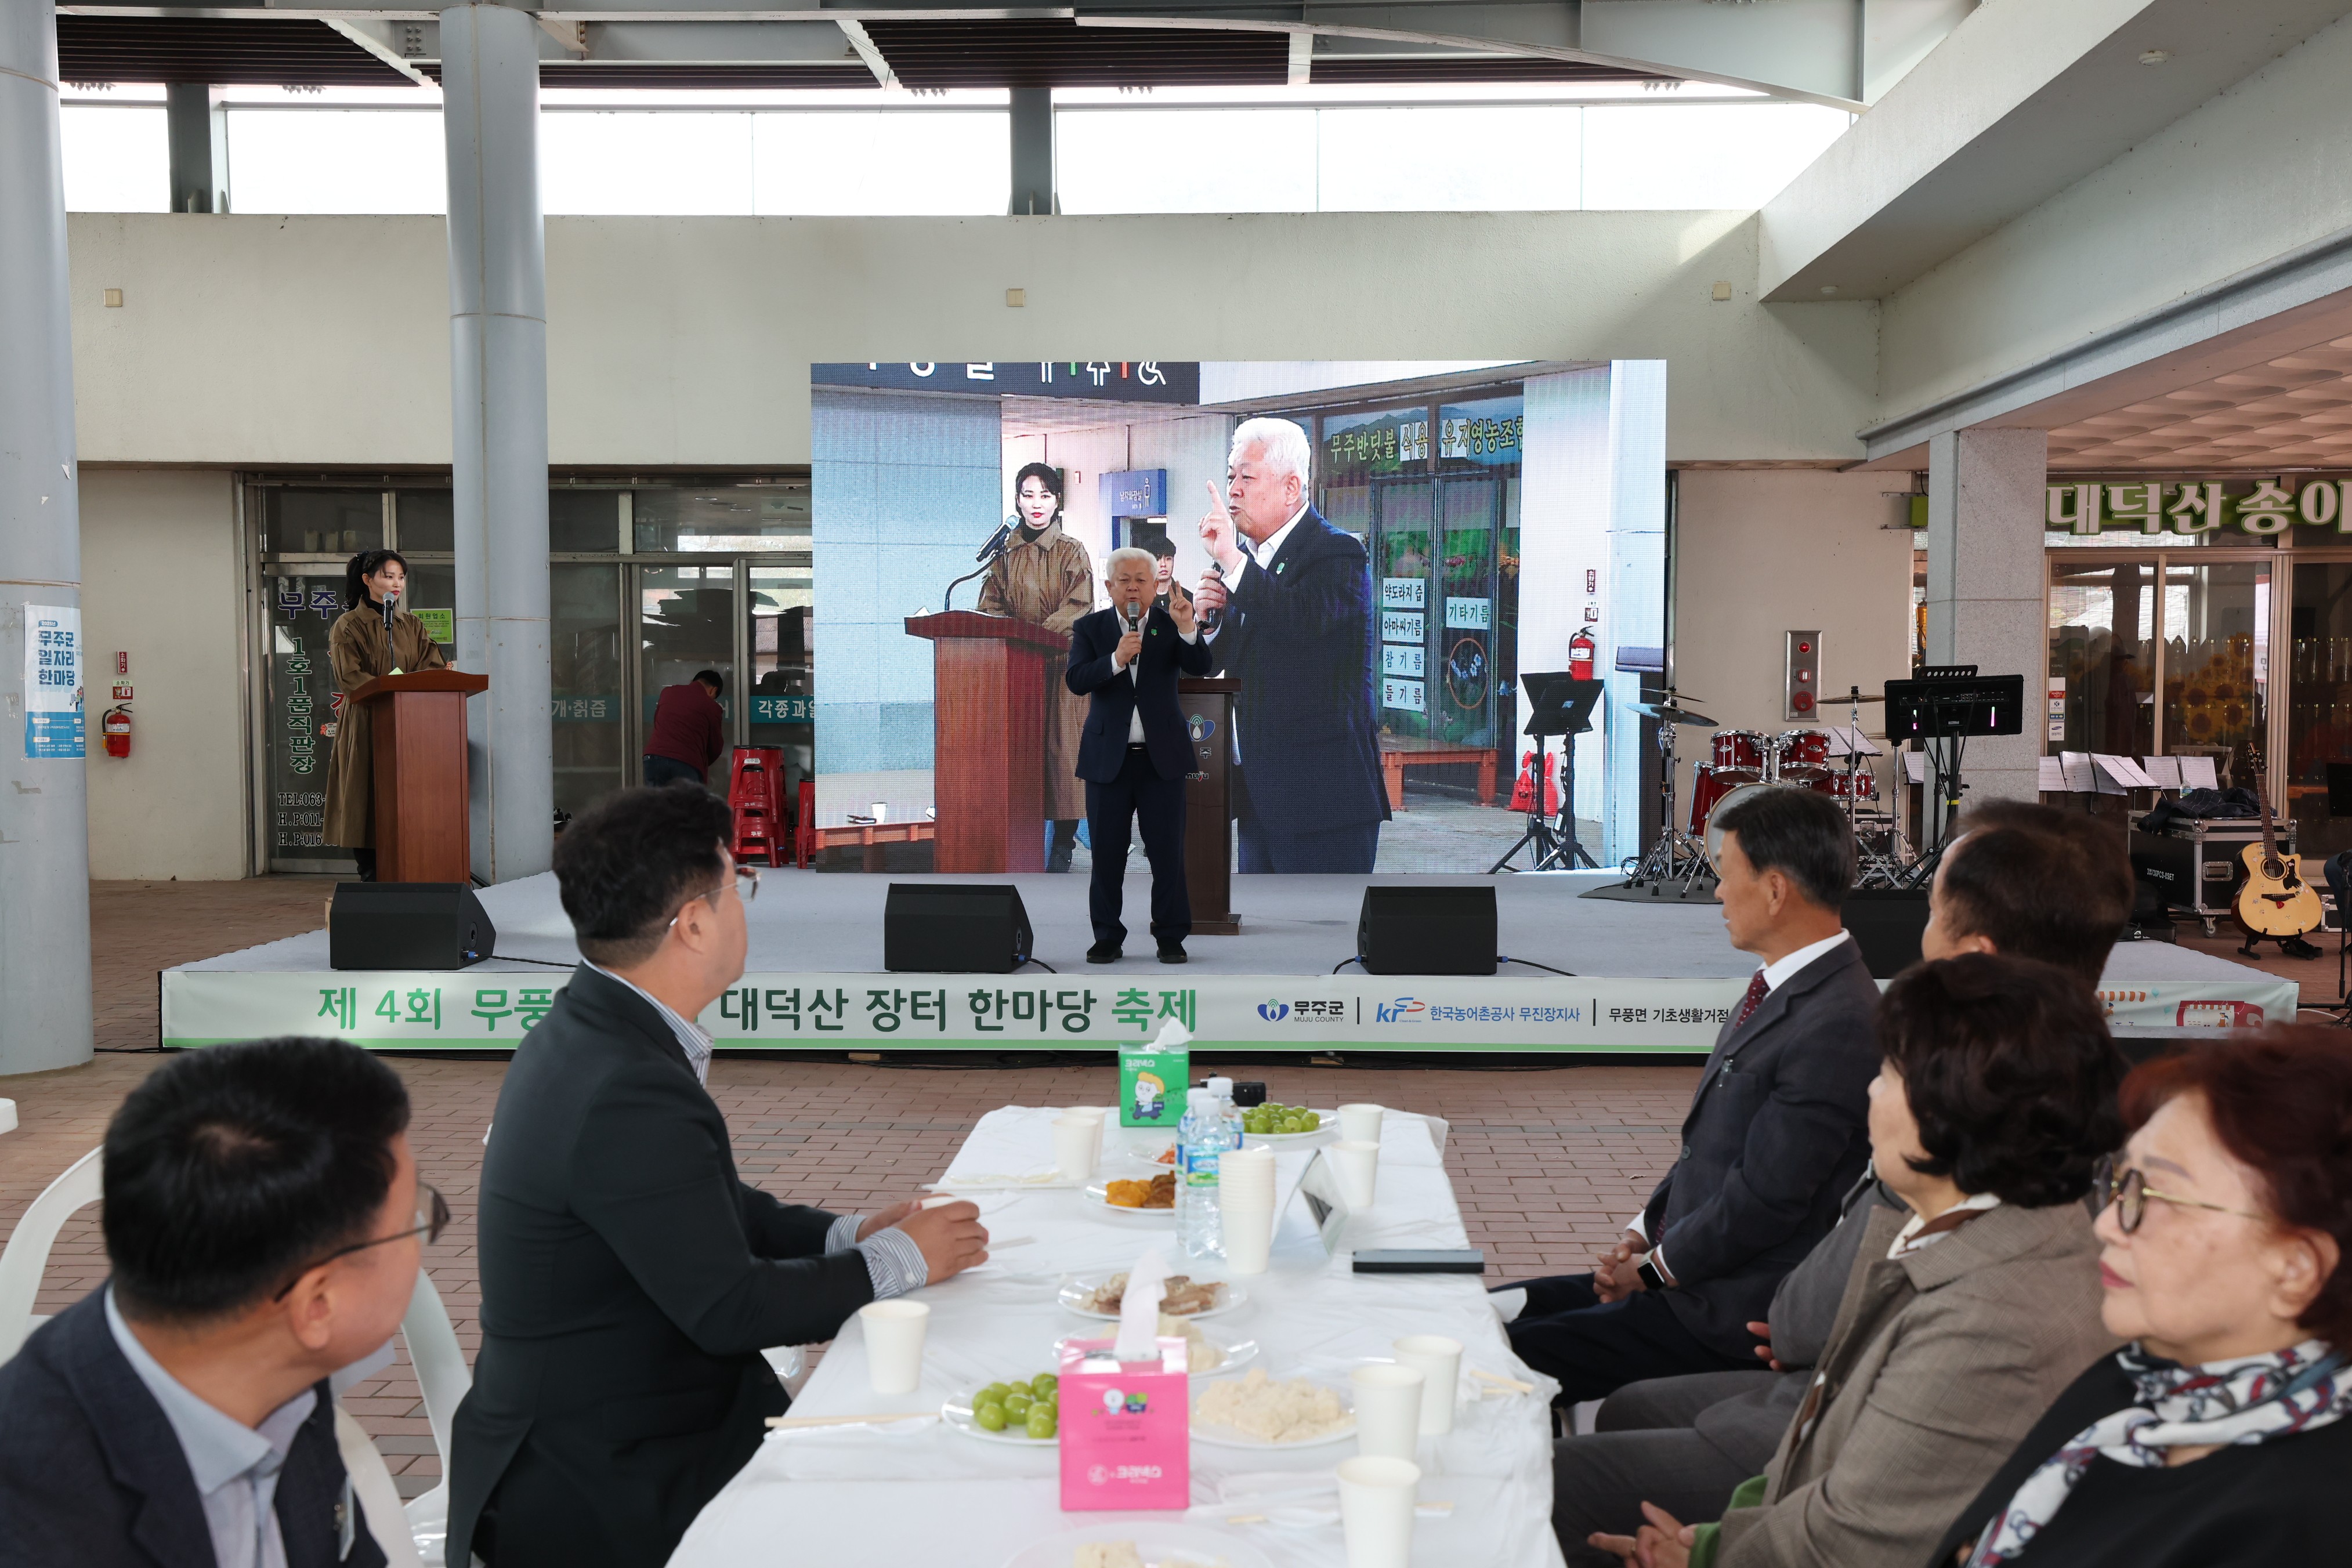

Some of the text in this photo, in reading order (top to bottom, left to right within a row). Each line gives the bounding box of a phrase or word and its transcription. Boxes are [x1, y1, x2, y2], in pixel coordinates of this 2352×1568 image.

[1330, 429, 1396, 463] 무주반딧불
[1401, 421, 1428, 460] 식용
[2047, 481, 2227, 535] 대덕산
[1385, 584, 1423, 602] 약도라지 즙
[1449, 604, 1489, 623] 기타기름
[1384, 618, 1420, 636] 아마씨기름
[38, 631, 74, 647] 무주군
[38, 650, 74, 666] 일자리
[38, 669, 75, 686] 한마당
[278, 792, 327, 806] TEL:063-
[317, 987, 356, 1030] 제
[374, 988, 441, 1030] 4회
[720, 988, 1196, 1033] 대덕산 장터 한마당 축제
[1294, 1001, 1344, 1015] 무주군
[1430, 1006, 1580, 1022] 한국농어촌공사 무진장지사
[1609, 1008, 1729, 1023] 무풍면 기초생활거점
